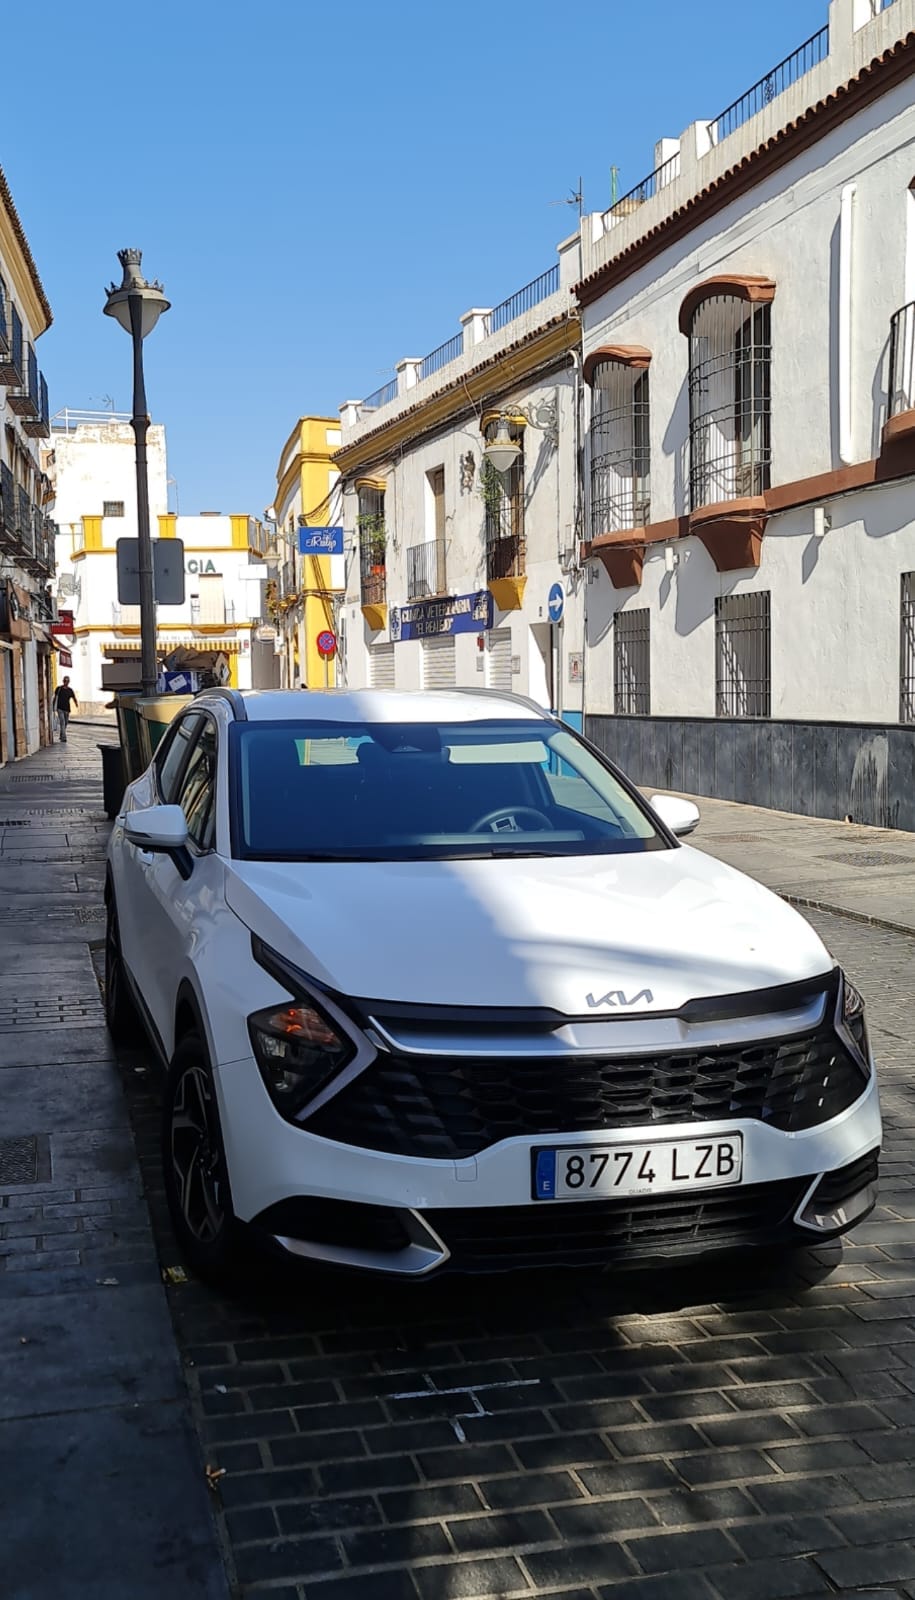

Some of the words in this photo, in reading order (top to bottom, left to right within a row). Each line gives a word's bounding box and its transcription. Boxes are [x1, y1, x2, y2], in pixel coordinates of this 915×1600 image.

[585, 988, 654, 1008] KIA
[565, 1150, 656, 1189] 8774
[671, 1143, 735, 1181] LZB
[543, 1181, 551, 1191] E
